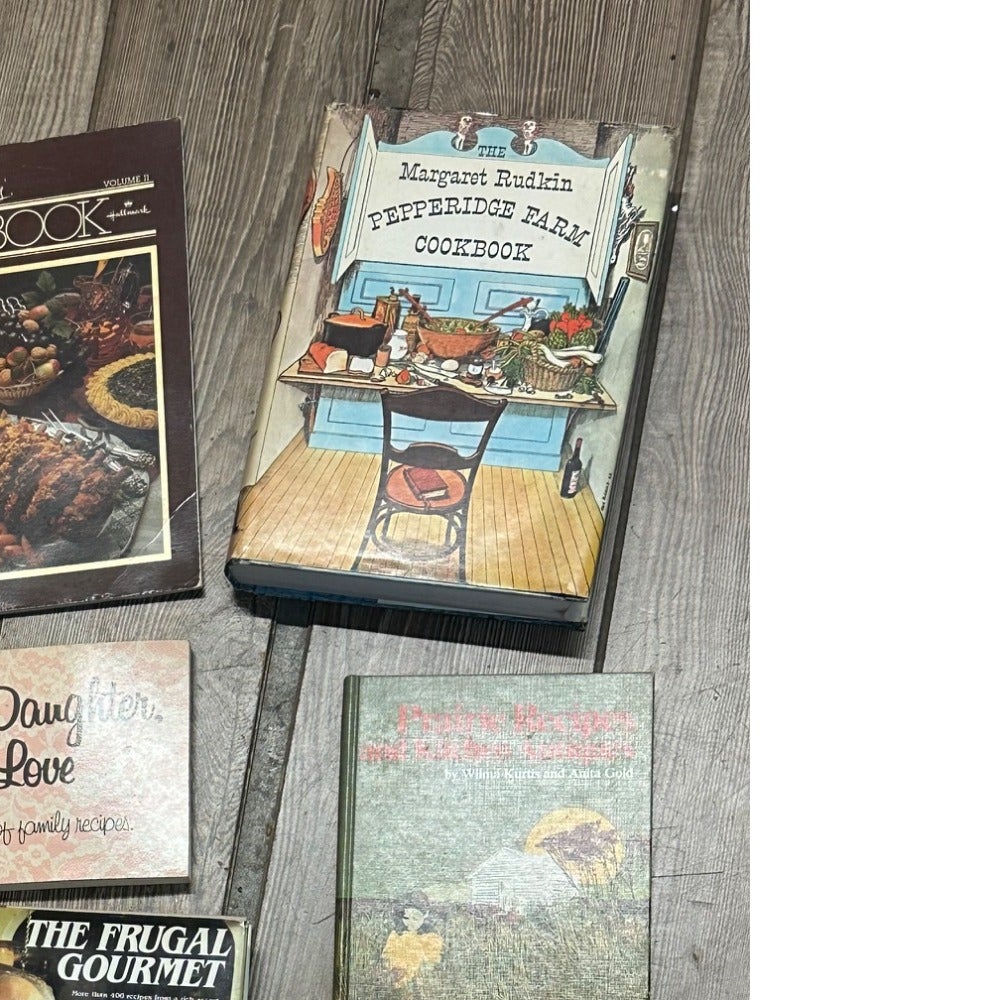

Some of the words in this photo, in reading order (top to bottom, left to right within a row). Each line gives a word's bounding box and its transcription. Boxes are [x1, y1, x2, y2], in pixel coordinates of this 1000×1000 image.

[478, 145, 507, 159] THE
[103, 175, 141, 188] VOLUME
[399, 162, 488, 188] Margaret
[494, 169, 574, 193] Rudkin
[106, 205, 151, 222] Hallmark
[368, 197, 516, 231] PEPPERIDGE
[521, 205, 591, 247] FARM
[415, 235, 534, 262] COOKBOOK
[396, 702, 505, 734] Prairie
[513, 702, 637, 739] Recipes
[444, 768, 457, 781] by
[460, 767, 501, 779] Wilma
[504, 768, 540, 780] Kurtis
[542, 767, 565, 779] and
[569, 767, 601, 779] Anita
[604, 766, 634, 779] Gold
[18, 810, 71, 844] family
[75, 814, 134, 836] recipes.
[26, 919, 91, 949] THE
[97, 923, 232, 957] FRUGAL
[57, 953, 226, 988] GOURMET
